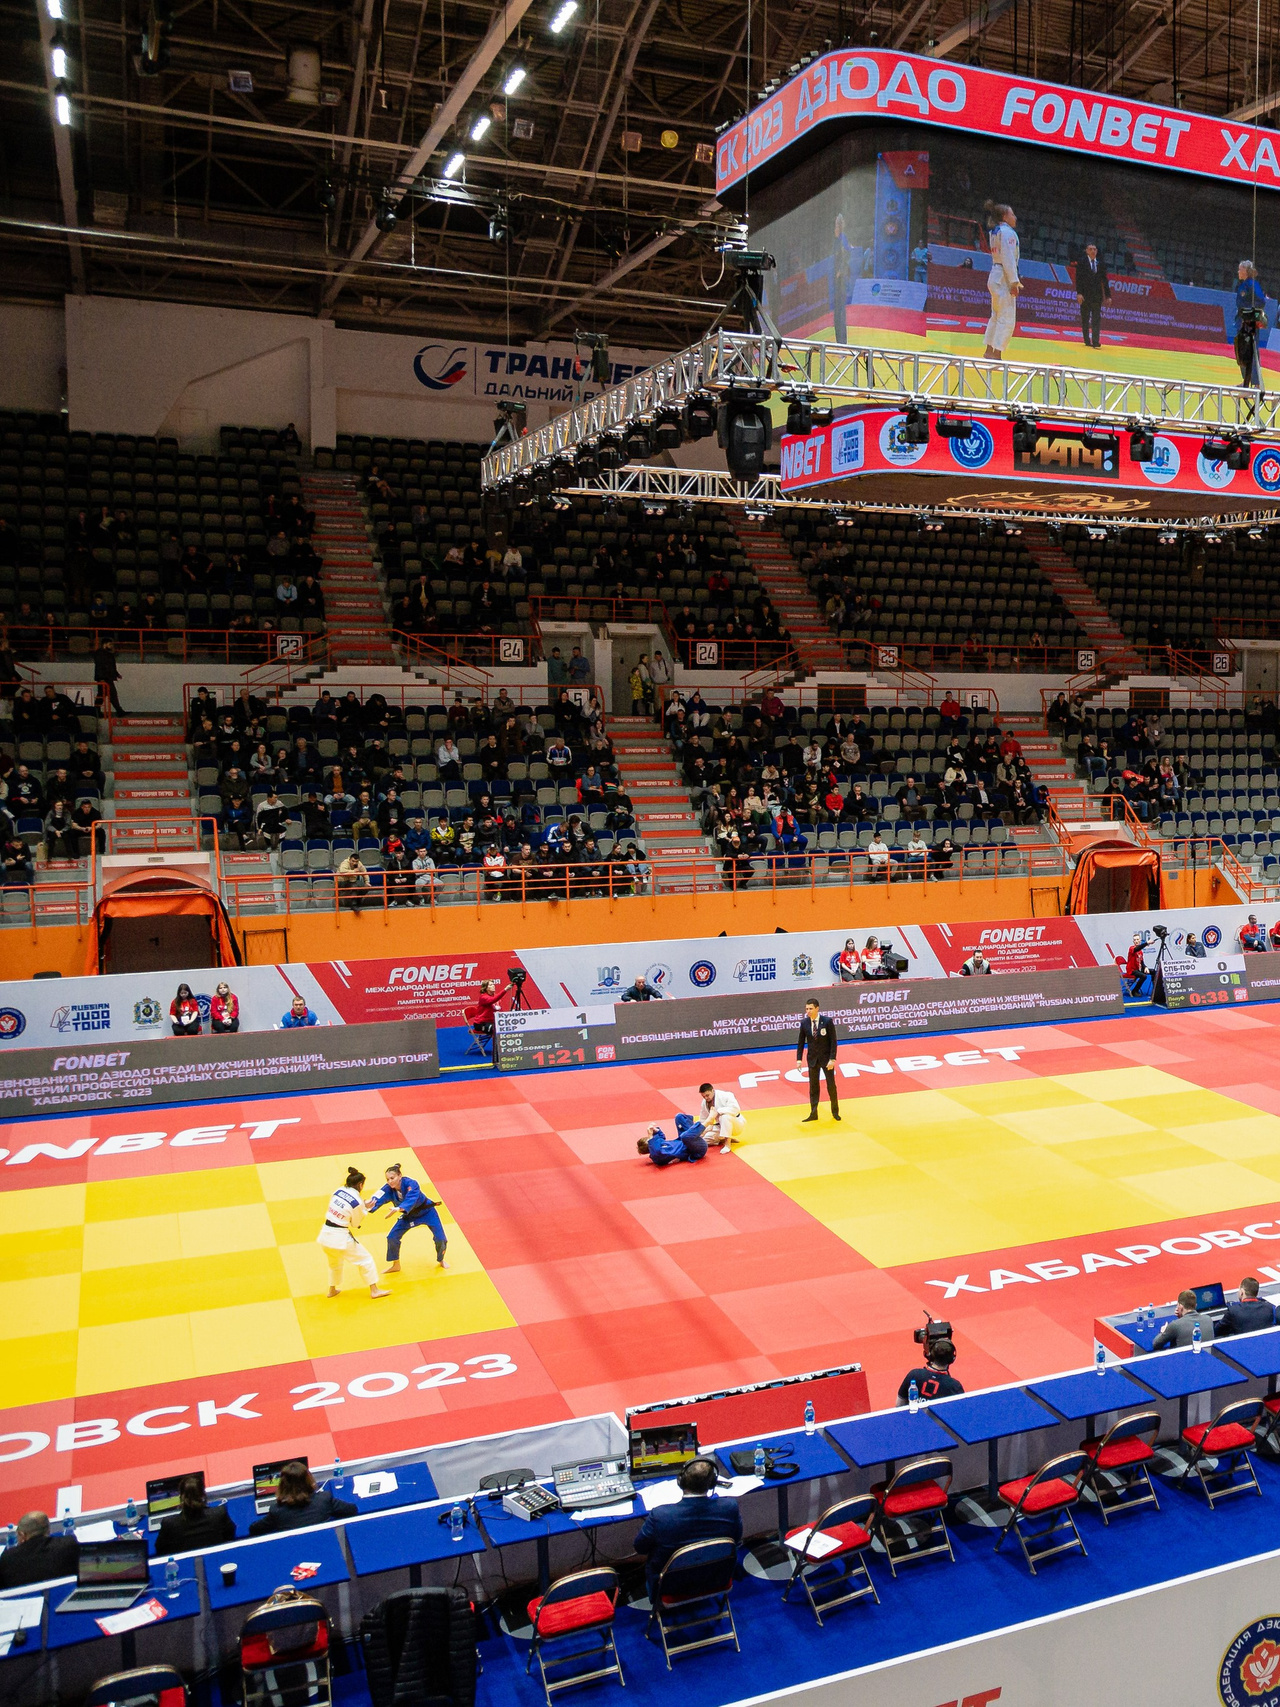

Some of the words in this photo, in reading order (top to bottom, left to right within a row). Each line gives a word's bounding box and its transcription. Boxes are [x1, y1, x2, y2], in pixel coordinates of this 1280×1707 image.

[742, 100, 784, 166] 2023
[795, 57, 967, 132] ДЗЮДО
[1000, 87, 1190, 158] FONBET
[484, 384, 572, 402] ДАЛЬНИЙ
[280, 640, 300, 655] 23
[503, 642, 520, 658] 24
[700, 646, 715, 661] 24
[1080, 653, 1092, 668] 25
[1215, 656, 1227, 670] 26
[979, 926, 1046, 943] FONBET
[962, 943, 1017, 951] МЕЖДУНАРОДНЫЕ
[1017, 939, 1062, 947] СОРЕВНОВАНИЯ
[749, 964, 776, 973] JUDO
[1163, 964, 1196, 972] СПБ-ПФО
[1218, 962, 1227, 971] 0
[388, 963, 479, 985] FONBET
[749, 972, 776, 982] TOUR
[1219, 974, 1230, 984] 0
[365, 984, 440, 994] МЕЖДУНАРОДНЫЕ
[425, 989, 455, 998] ДЗЮДО
[436, 995, 471, 1003] ОЩЕПКОВА
[859, 989, 910, 1005] FONBET
[1190, 990, 1229, 1005] 0:38
[71, 1003, 110, 1011] RUSSIAN
[713, 1013, 802, 1028] МЕЖДУНАРОДНЫЕ
[877, 1006, 891, 1014] ПО
[892, 1003, 926, 1014] ДЗЮДО
[926, 1000, 956, 1009] СРЕДИ
[957, 996, 995, 1007] МУЖЧИН
[1004, 993, 1045, 1003] ЖЕНЩИН,
[72, 1010, 110, 1022] JUDO
[403, 1010, 445, 1021] Хабаровск
[498, 1018, 527, 1027] СКФО
[576, 1013, 587, 1024] 1
[621, 1030, 699, 1044] ПОСВЯЩЕННЫЕ
[700, 1026, 741, 1038] ПАМЯТИ
[742, 1025, 760, 1034] В.С.
[843, 1016, 872, 1025] СЕРИИ
[873, 1008, 968, 1023] ПРОФЕССИОНАЛЬНЫХ
[969, 1001, 1035, 1013] СОРЕВНОВАНИЙ
[1036, 998, 1073, 1007] "RUSSIAN
[1074, 996, 1094, 1004] JUDO
[1095, 993, 1119, 1002] TOUR"
[72, 1020, 111, 1032] TOUR
[849, 1022, 901, 1033] ХАБАРОВСК
[908, 1019, 928, 1028] 2023
[578, 1028, 589, 1040] 1
[500, 1038, 522, 1047] СФО
[53, 1052, 131, 1071] FONBET
[532, 1048, 585, 1066] 1:21
[598, 1052, 614, 1060] BET
[80, 1072, 98, 1082] ПО
[100, 1068, 151, 1081] ДЗЮДО
[152, 1064, 196, 1076] СРЕДИ
[198, 1059, 254, 1074] МУЖЧИН
[256, 1058, 265, 1067] И
[267, 1054, 326, 1068] ЖЕНЩИН,
[738, 1044, 1025, 1089] FONBET
[25, 1085, 70, 1097] СЕРИИ
[72, 1073, 212, 1092] ПРОФЕССИОНАЛЬНЫХ
[214, 1063, 311, 1080] СОРЕВНОВАНИЙ
[313, 1058, 367, 1072] "RUSSIAN
[368, 1056, 396, 1067] JUDO
[398, 1053, 434, 1064] TOUR"
[33, 1090, 112, 1106] ХАБАРОВСК
[122, 1087, 153, 1098] 2023
[0, 1392, 263, 1463] ОВСК
[289, 1353, 518, 1411] 2023
